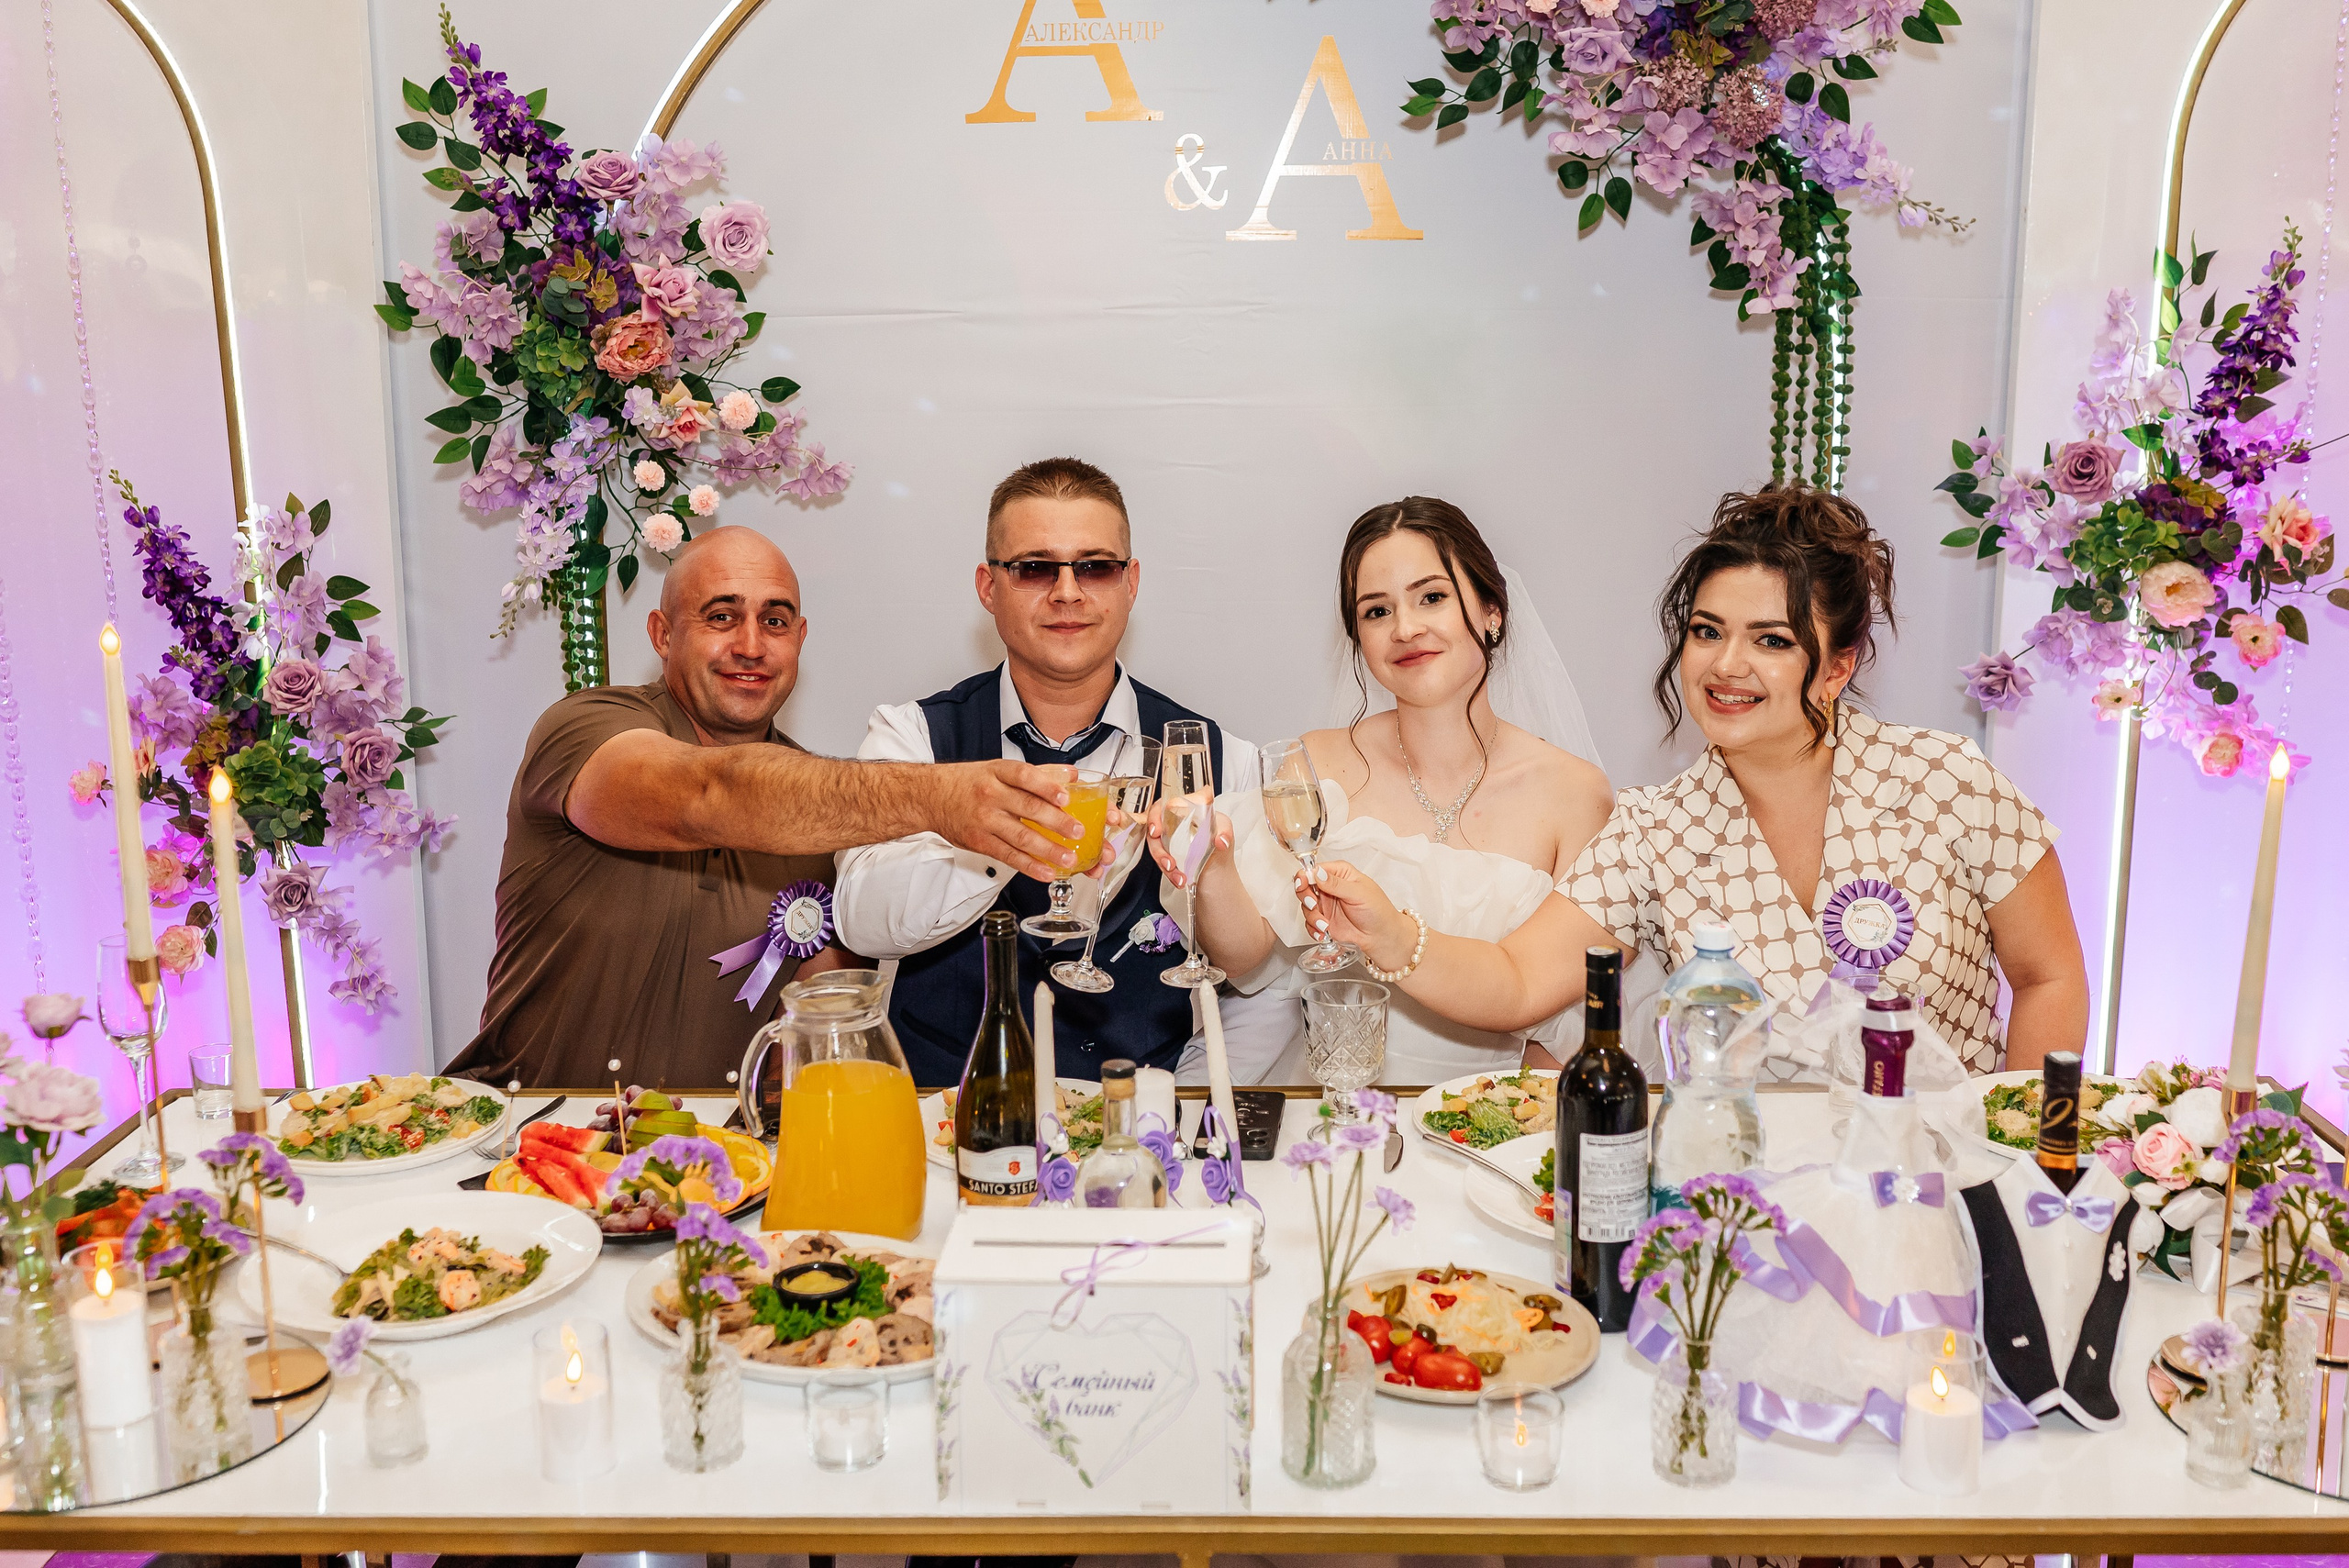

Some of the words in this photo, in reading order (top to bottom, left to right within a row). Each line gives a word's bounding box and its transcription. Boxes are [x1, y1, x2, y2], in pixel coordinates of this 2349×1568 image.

[1025, 21, 1165, 43] АЛЕКСАНДР
[1322, 141, 1394, 161] АННА
[1164, 133, 1229, 211] &
[968, 1179, 1006, 1195] SANTO
[1032, 1362, 1156, 1396] Семейный
[1065, 1396, 1121, 1418] банк
